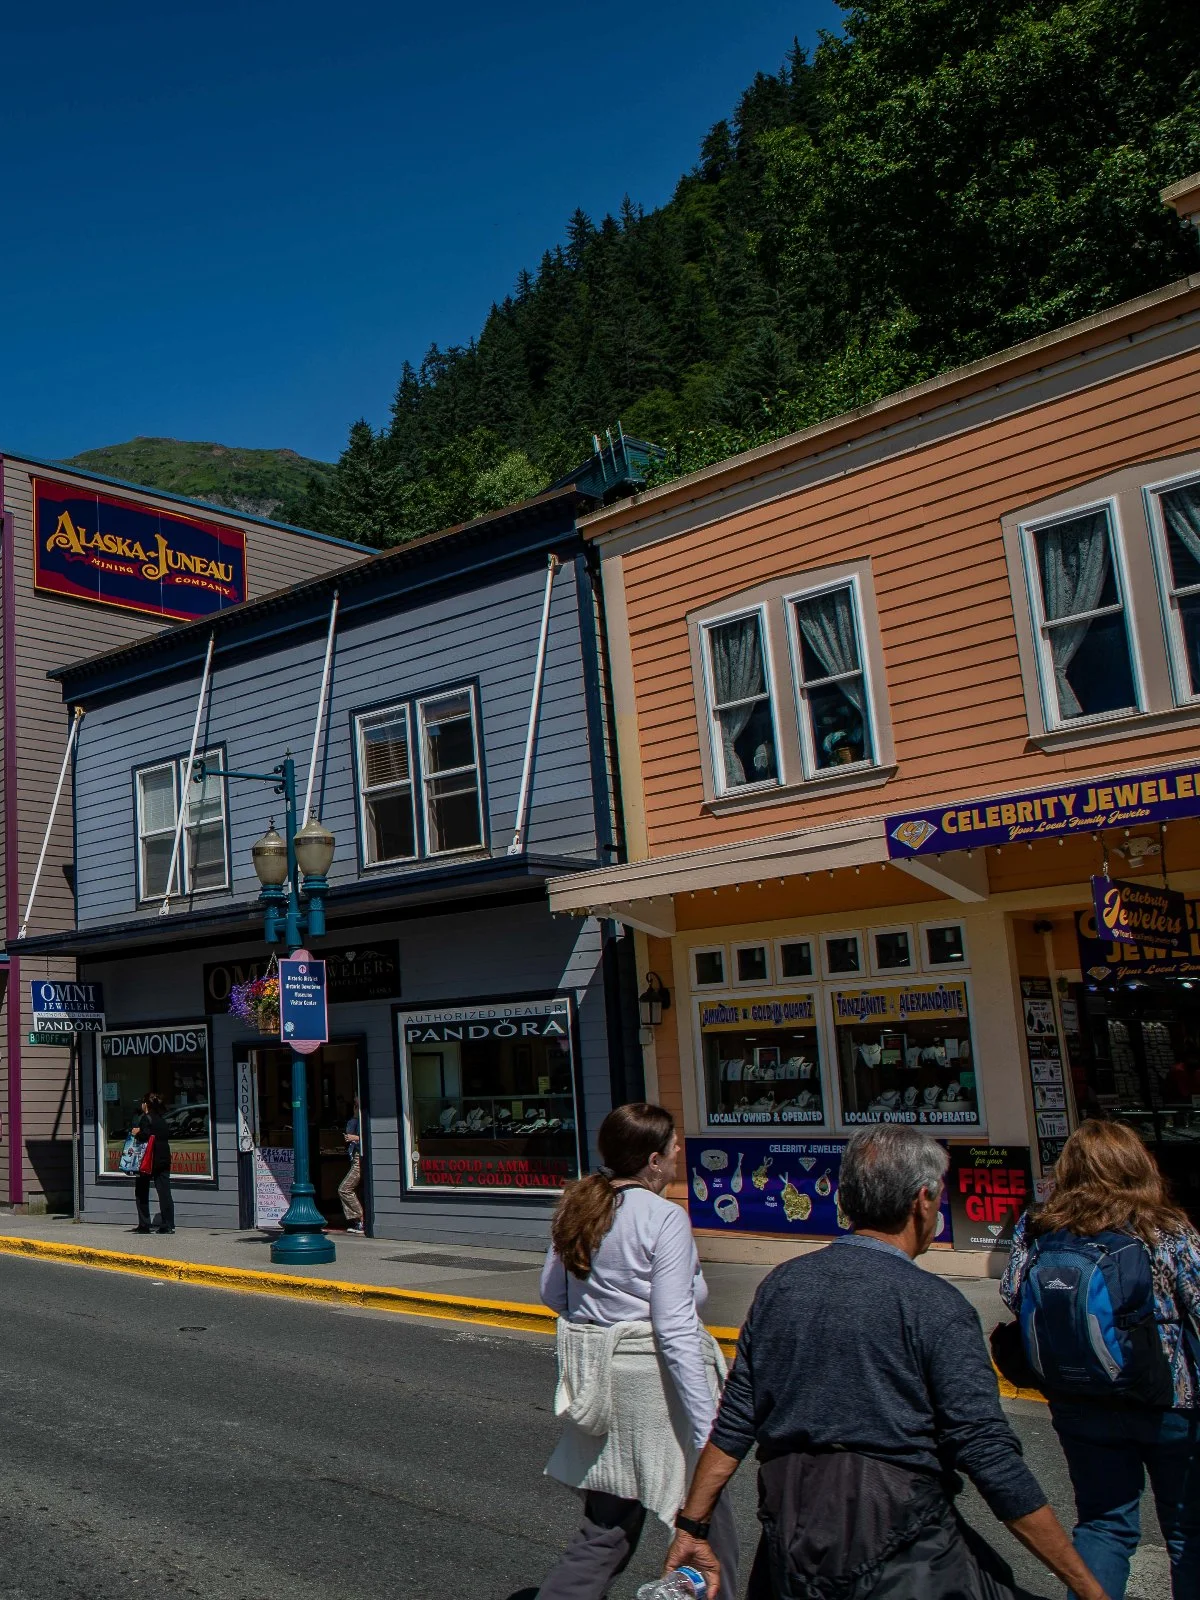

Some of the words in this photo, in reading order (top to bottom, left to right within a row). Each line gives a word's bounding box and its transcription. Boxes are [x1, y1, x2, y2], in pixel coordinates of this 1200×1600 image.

[91, 558, 134, 575] MINING
[174, 576, 230, 596] COMPANY
[941, 793, 1077, 834] CELEBRITY
[1008, 824, 1034, 841] Your
[1035, 818, 1068, 833] Local
[1068, 814, 1105, 829] Family
[1106, 807, 1151, 825] Jeweler
[1121, 886, 1169, 914] Celebrity
[1103, 888, 1182, 935] Jewelers
[327, 958, 395, 979] WELERS
[1116, 966, 1142, 980] Your
[1143, 964, 1177, 975] Local
[40, 983, 96, 1002] OMNI
[43, 1002, 96, 1011] JEWELERS
[783, 1001, 812, 1019] QUARTZ
[837, 995, 887, 1017] TANZANITE
[899, 989, 963, 1013] ALEXANDRITE
[406, 1008, 497, 1024] AUTHORIZED
[504, 1004, 563, 1017] DEALER
[38, 1020, 102, 1031] PANDORA
[407, 1018, 565, 1043] PANDORA
[111, 1032, 198, 1056] DIAMONDS
[241, 1063, 249, 1135] PANDORA
[709, 1112, 742, 1123] LOCALLY
[742, 1112, 772, 1123] OWNED
[773, 1112, 781, 1122] &
[781, 1111, 823, 1122] OPERATED
[845, 1112, 882, 1123] LOCALLY
[882, 1112, 917, 1123] OWNED
[918, 1112, 927, 1123] &
[928, 1111, 977, 1123] OPERATED
[769, 1144, 807, 1153] CELEBRITY
[808, 1144, 846, 1153] JEWELERS
[969, 1147, 988, 1156] Come
[989, 1147, 1000, 1156] On
[421, 1159, 448, 1172] 18KT
[448, 1159, 483, 1172] GOLD
[974, 1157, 986, 1167] for
[986, 1158, 1004, 1168] your
[425, 1172, 463, 1185] TOPAZ
[477, 1172, 512, 1186] GOLD
[957, 1167, 1027, 1195] FREE
[965, 1195, 1024, 1223] GIFT
